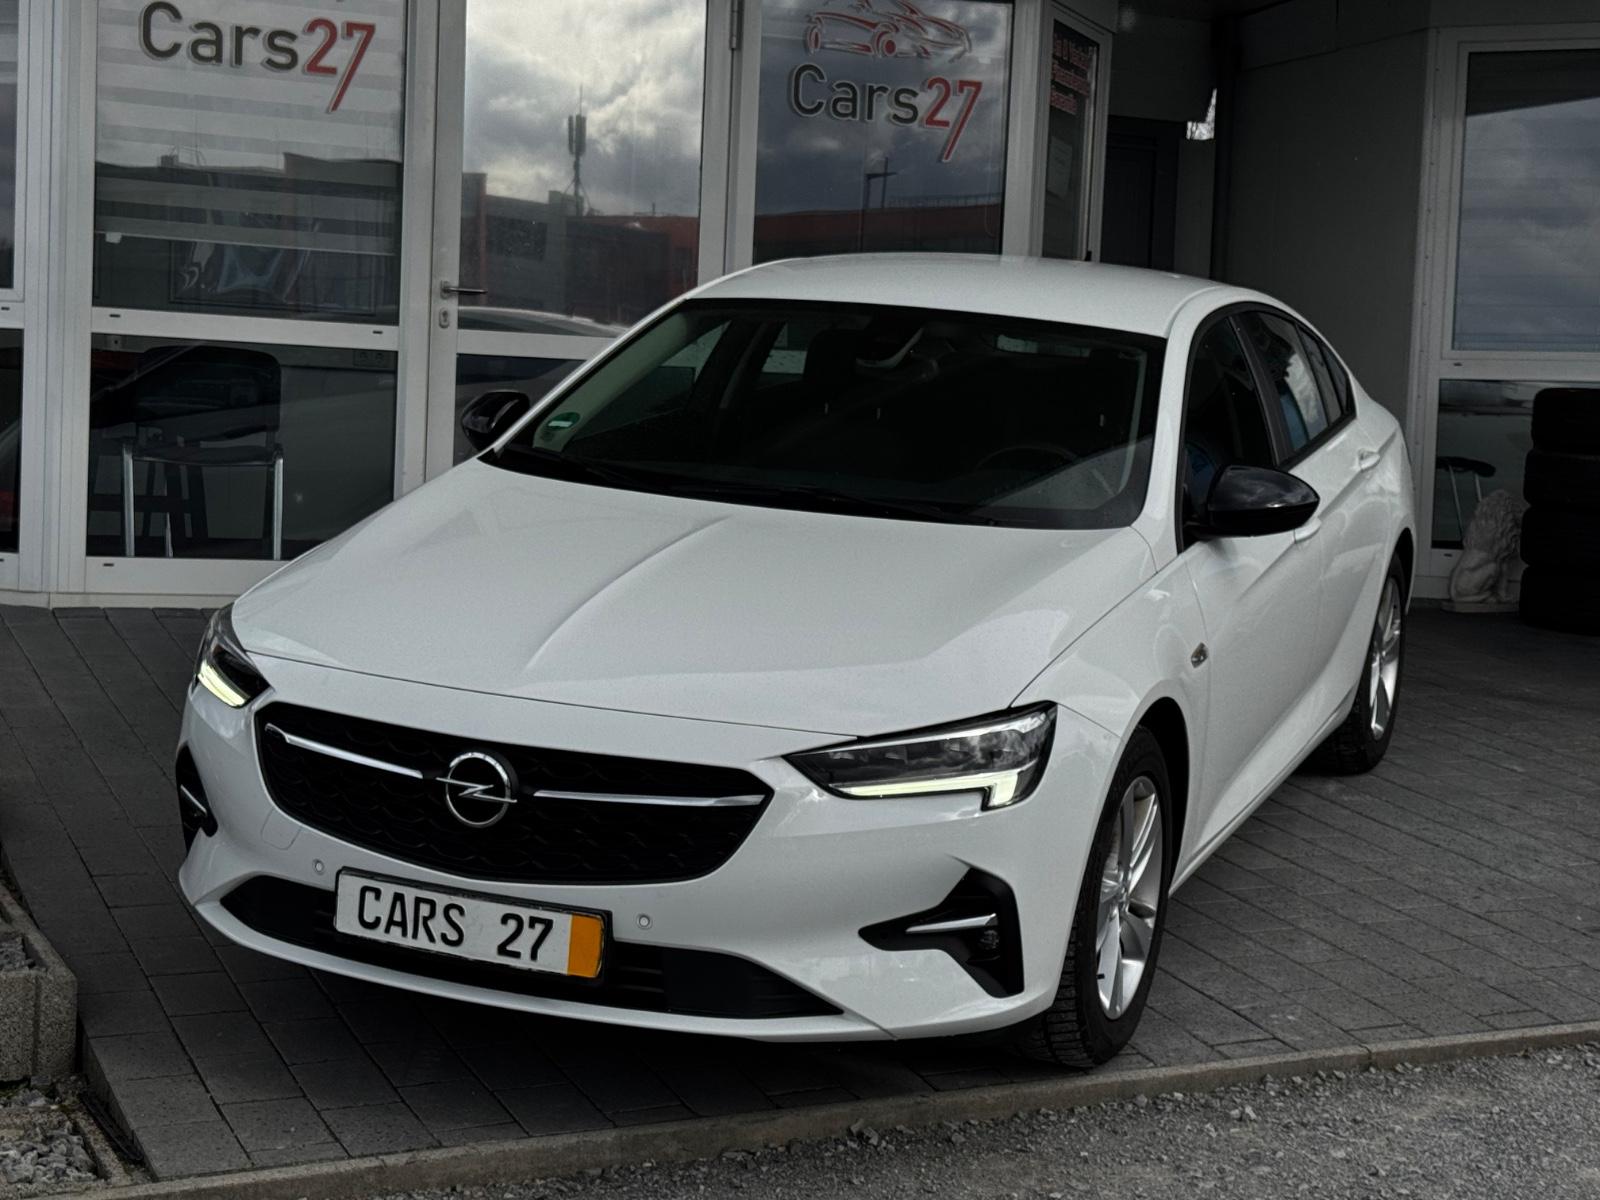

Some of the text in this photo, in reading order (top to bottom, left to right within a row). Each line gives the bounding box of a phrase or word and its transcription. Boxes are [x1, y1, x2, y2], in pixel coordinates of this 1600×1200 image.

[140, 1, 376, 113] Cars27
[792, 63, 982, 162] Cars27
[358, 885, 554, 961] CARS 27
